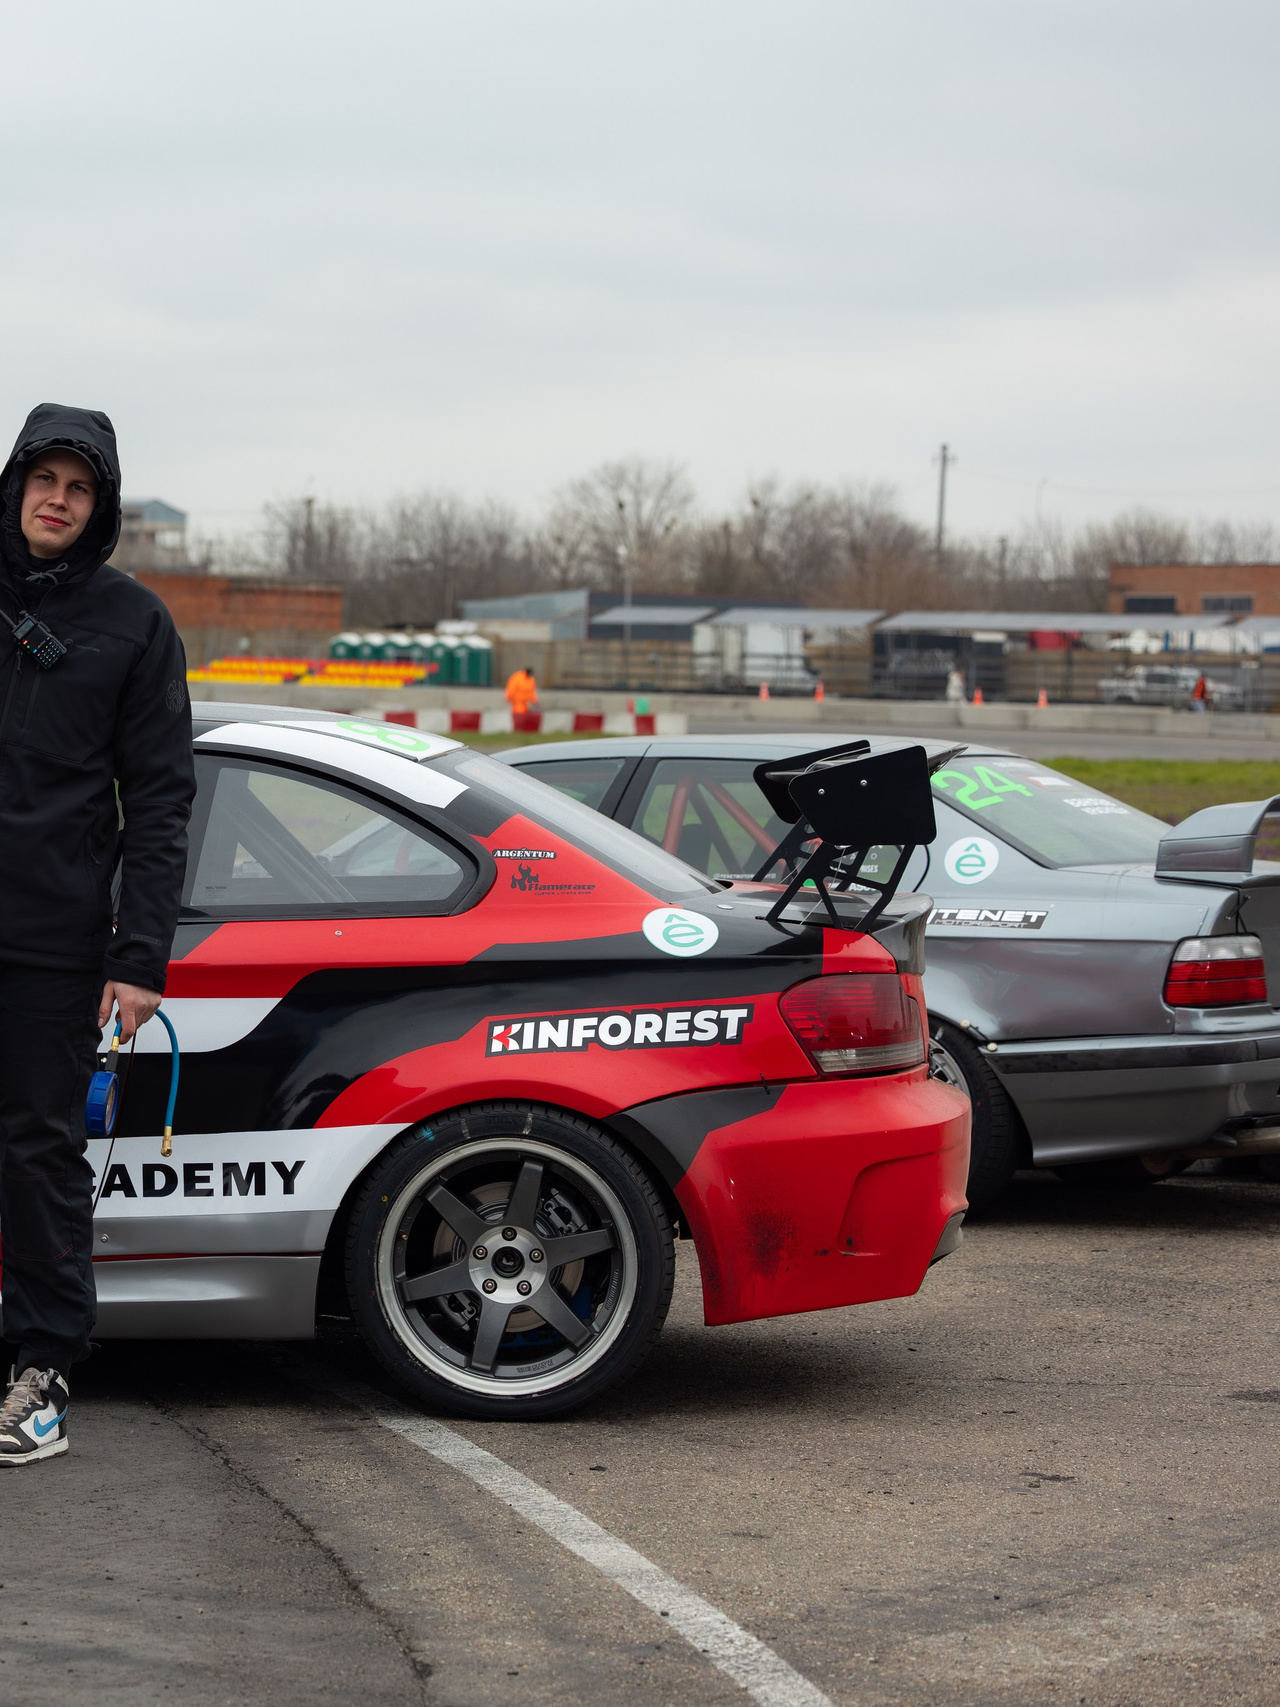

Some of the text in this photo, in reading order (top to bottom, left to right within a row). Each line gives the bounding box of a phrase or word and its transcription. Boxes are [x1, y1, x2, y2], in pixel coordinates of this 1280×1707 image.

[336, 721, 431, 752] 8
[930, 765, 1034, 811] 24
[493, 849, 555, 858] ARGENTUM
[491, 1008, 748, 1053] KINFOREST
[91, 1159, 307, 1199] ADEMY
